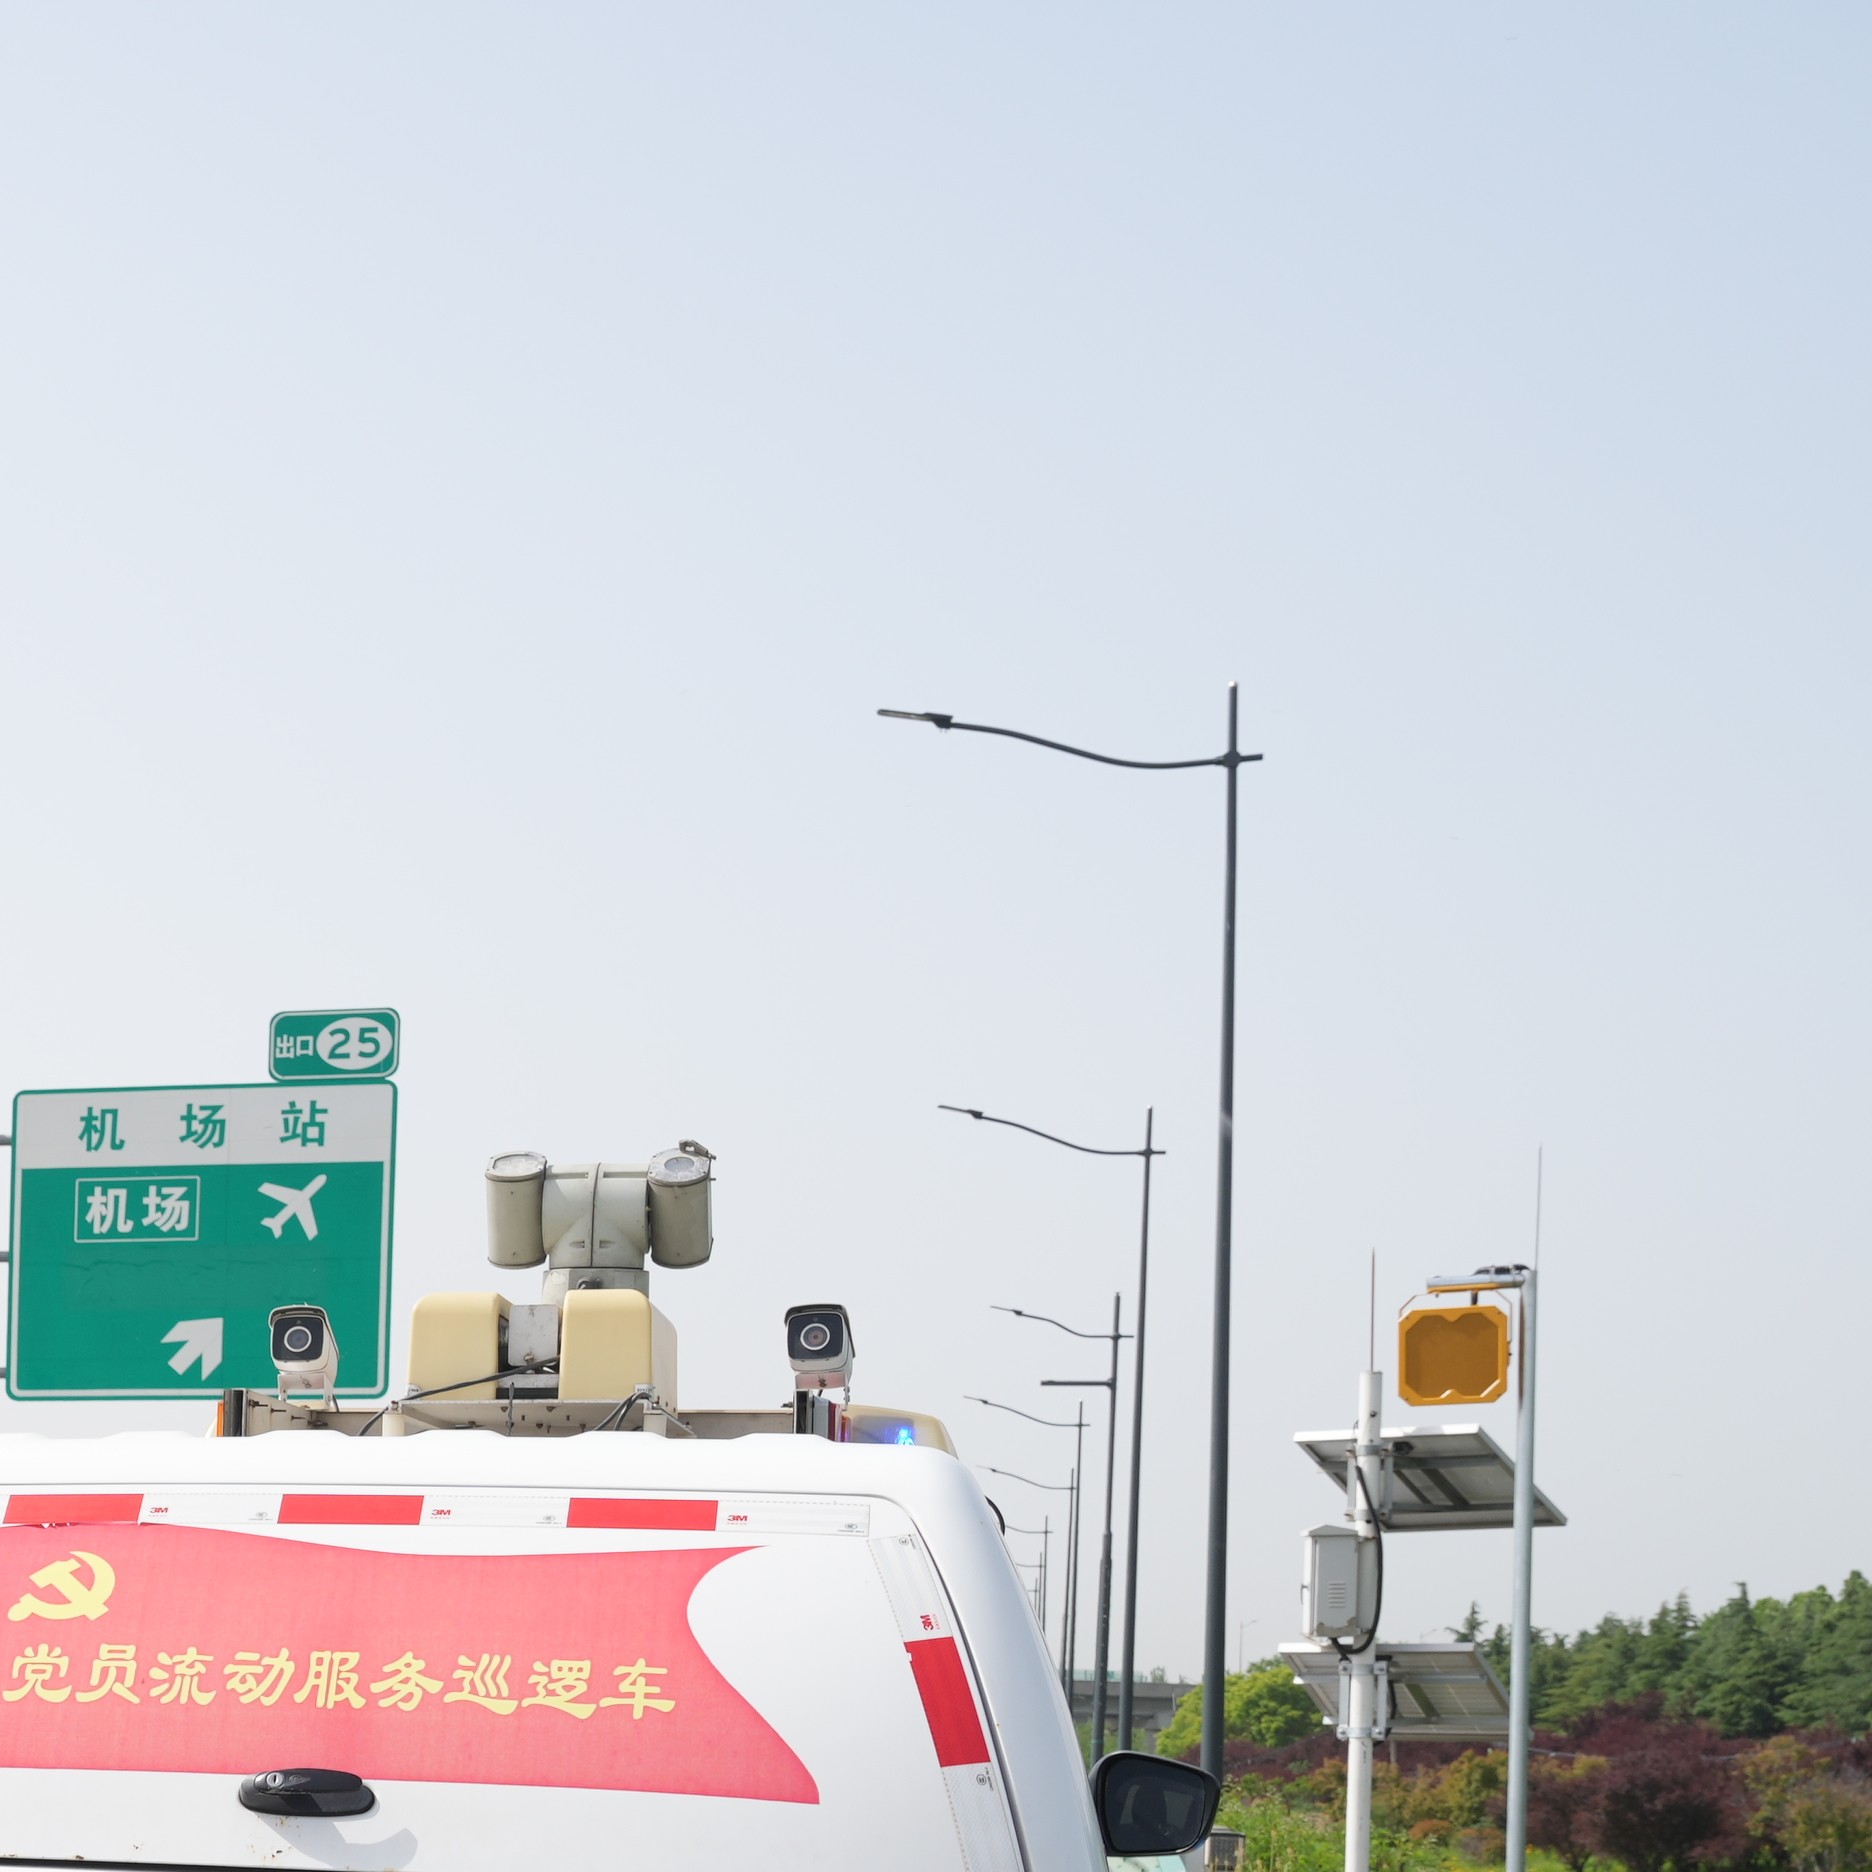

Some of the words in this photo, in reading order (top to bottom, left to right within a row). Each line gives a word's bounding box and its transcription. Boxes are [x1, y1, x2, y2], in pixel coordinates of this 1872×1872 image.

[275, 1034, 314, 1059] 出口
[327, 1027, 381, 1060] 25
[78, 1100, 329, 1152] 机场站
[85, 1185, 190, 1235] 机场
[149, 1506, 169, 1514] 3M
[431, 1508, 452, 1516] 3M
[727, 1514, 748, 1522] 3M
[920, 1614, 934, 1631] 3M
[2, 1642, 677, 1720] 党员流动服务巡逻车
